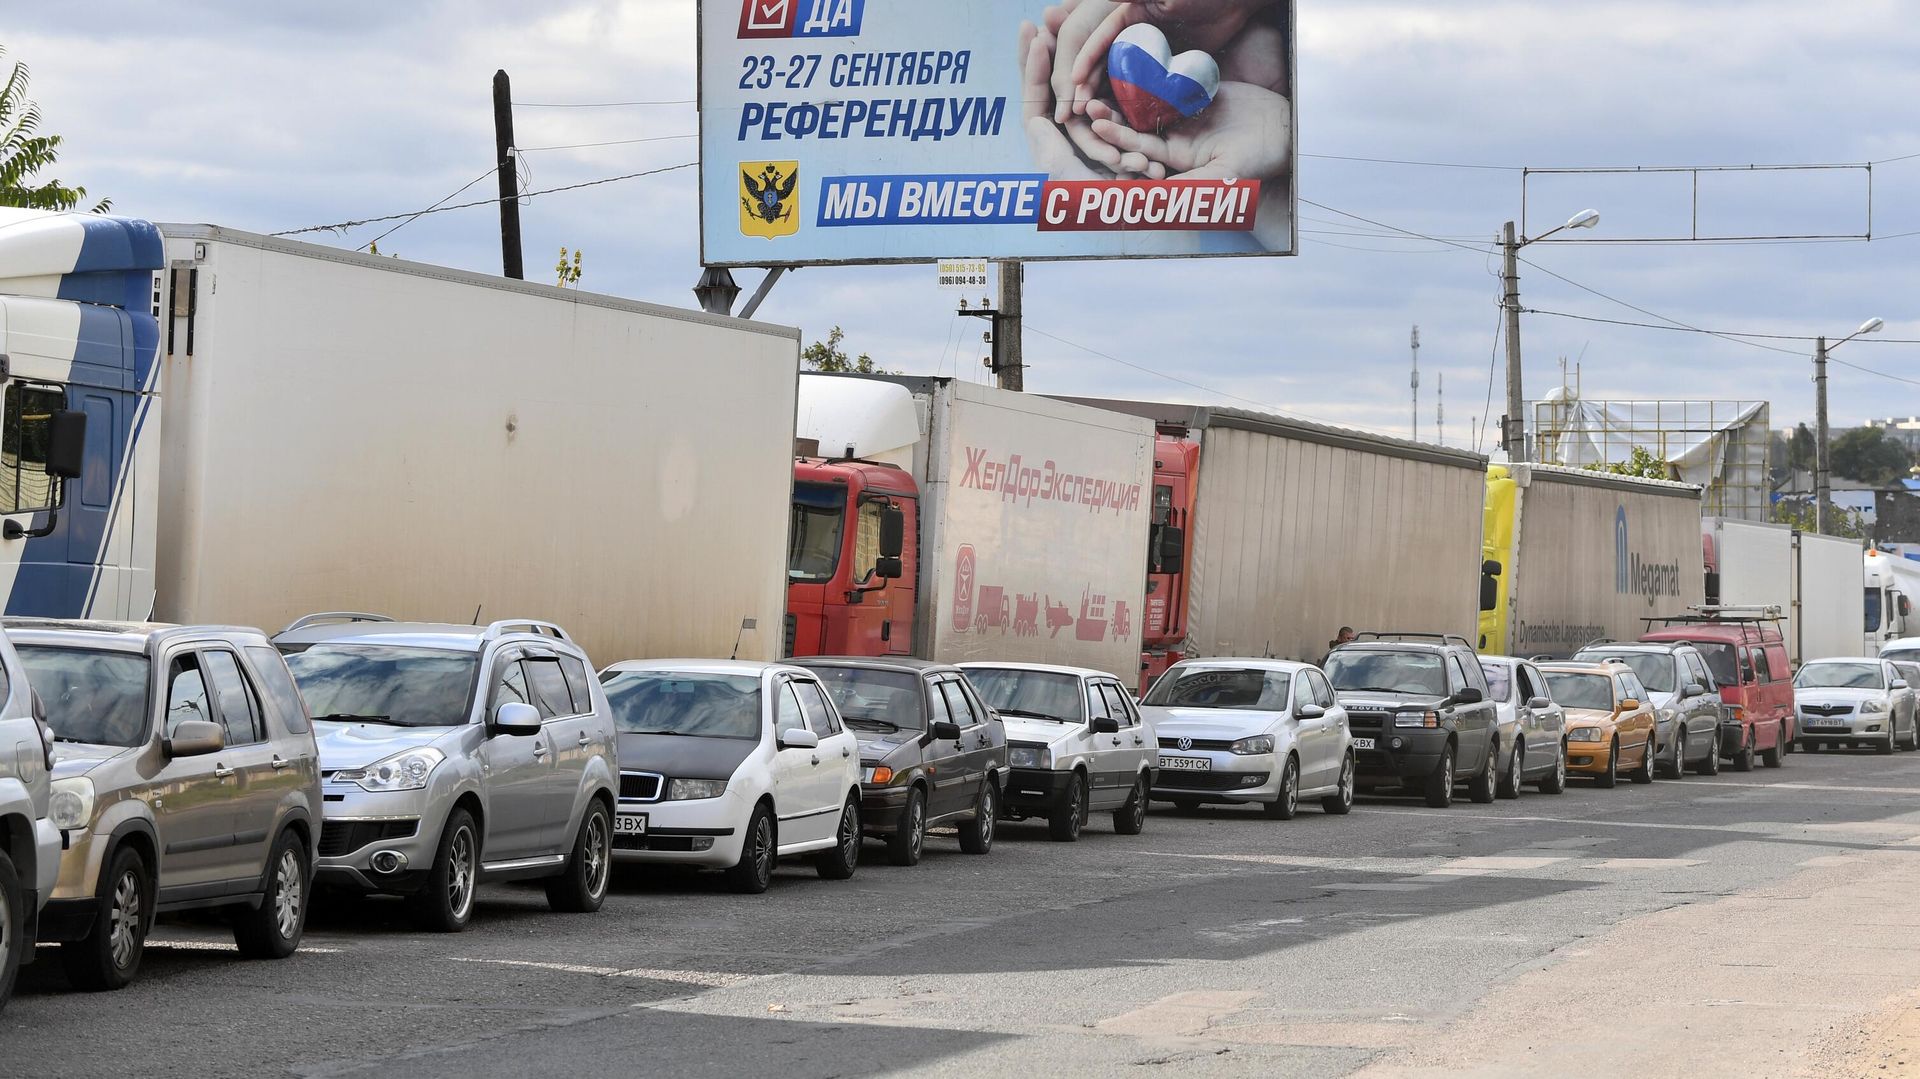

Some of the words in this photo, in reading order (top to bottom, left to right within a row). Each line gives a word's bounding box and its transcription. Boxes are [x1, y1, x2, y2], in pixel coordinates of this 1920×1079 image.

[803, 0, 851, 33] ДА
[739, 55, 822, 89] 23-27
[829, 50, 971, 88] СЕНТЯБРЯ
[738, 97, 1006, 141] РЕФЕРЕНДУМ
[824, 182, 892, 220] МЫ
[898, 181, 1039, 218] ВМЕСТЕ
[1045, 187, 1070, 225] С
[1076, 177, 1251, 225] РОССИЕЙ!
[959, 446, 1141, 517] ЖелДорЭкспедиция
[1630, 551, 1680, 608] Megamat
[1159, 758, 1173, 767] BT
[1174, 759, 1194, 768] 5591
[1195, 760, 1209, 770] CK
